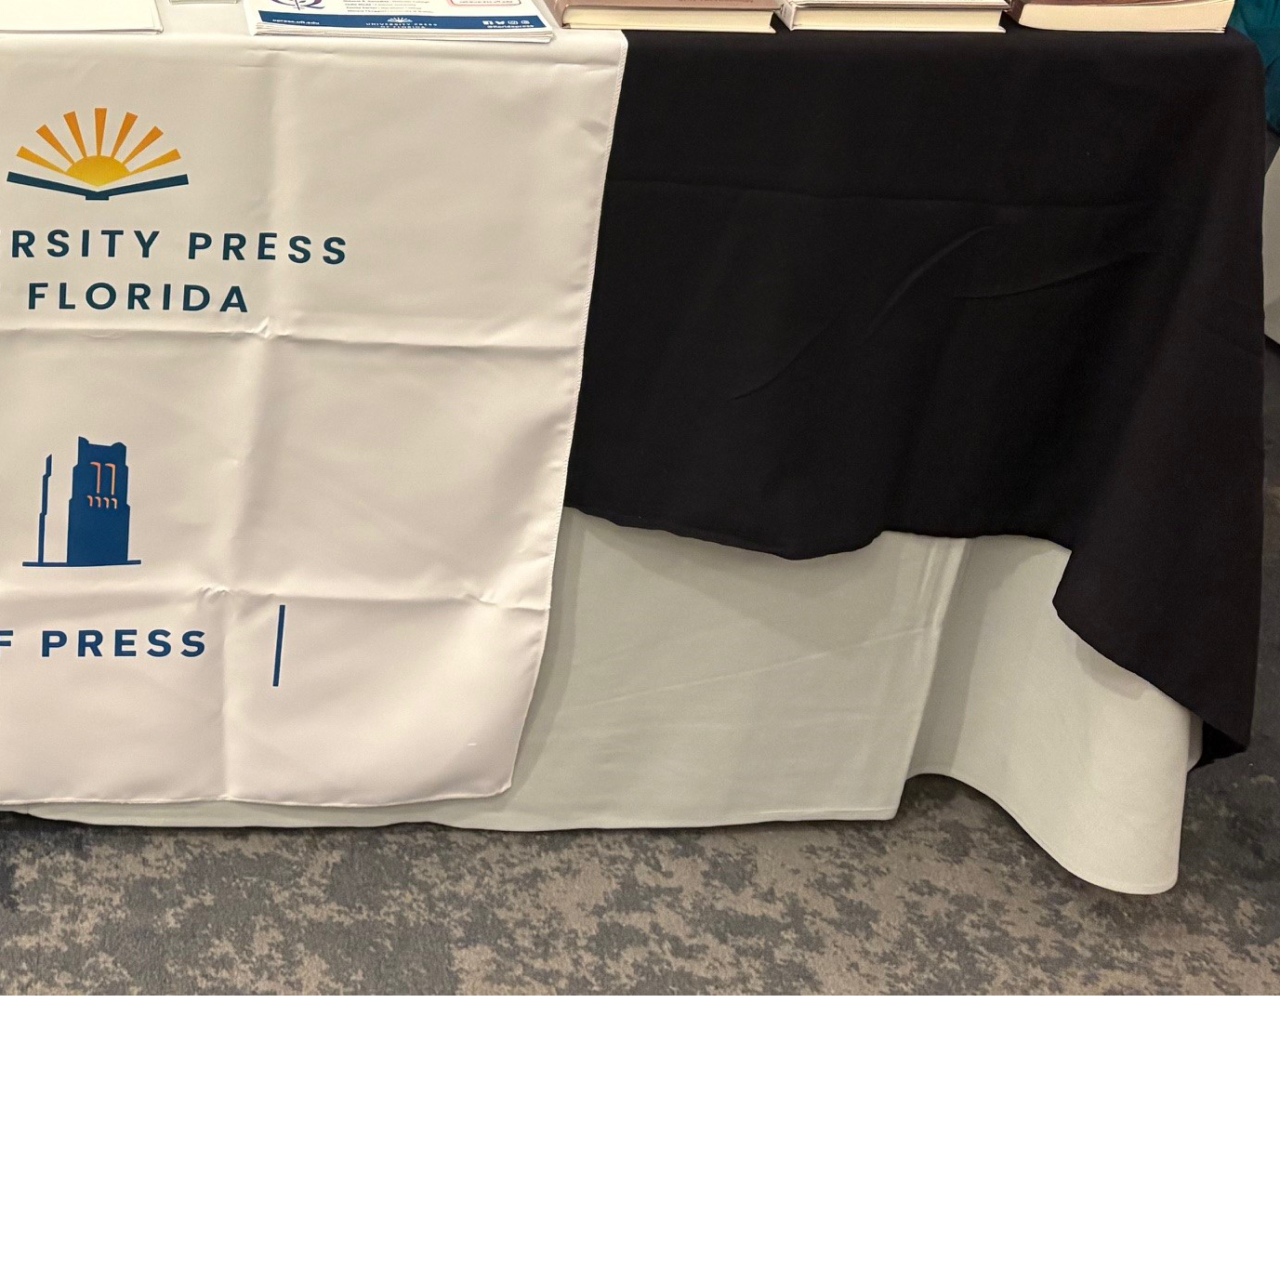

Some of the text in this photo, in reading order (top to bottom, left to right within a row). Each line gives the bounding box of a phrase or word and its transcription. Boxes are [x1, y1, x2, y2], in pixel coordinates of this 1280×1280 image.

[187, 232, 347, 265] PRESS
[28, 282, 249, 313] FLORIDA
[41, 629, 207, 657] PRESS
